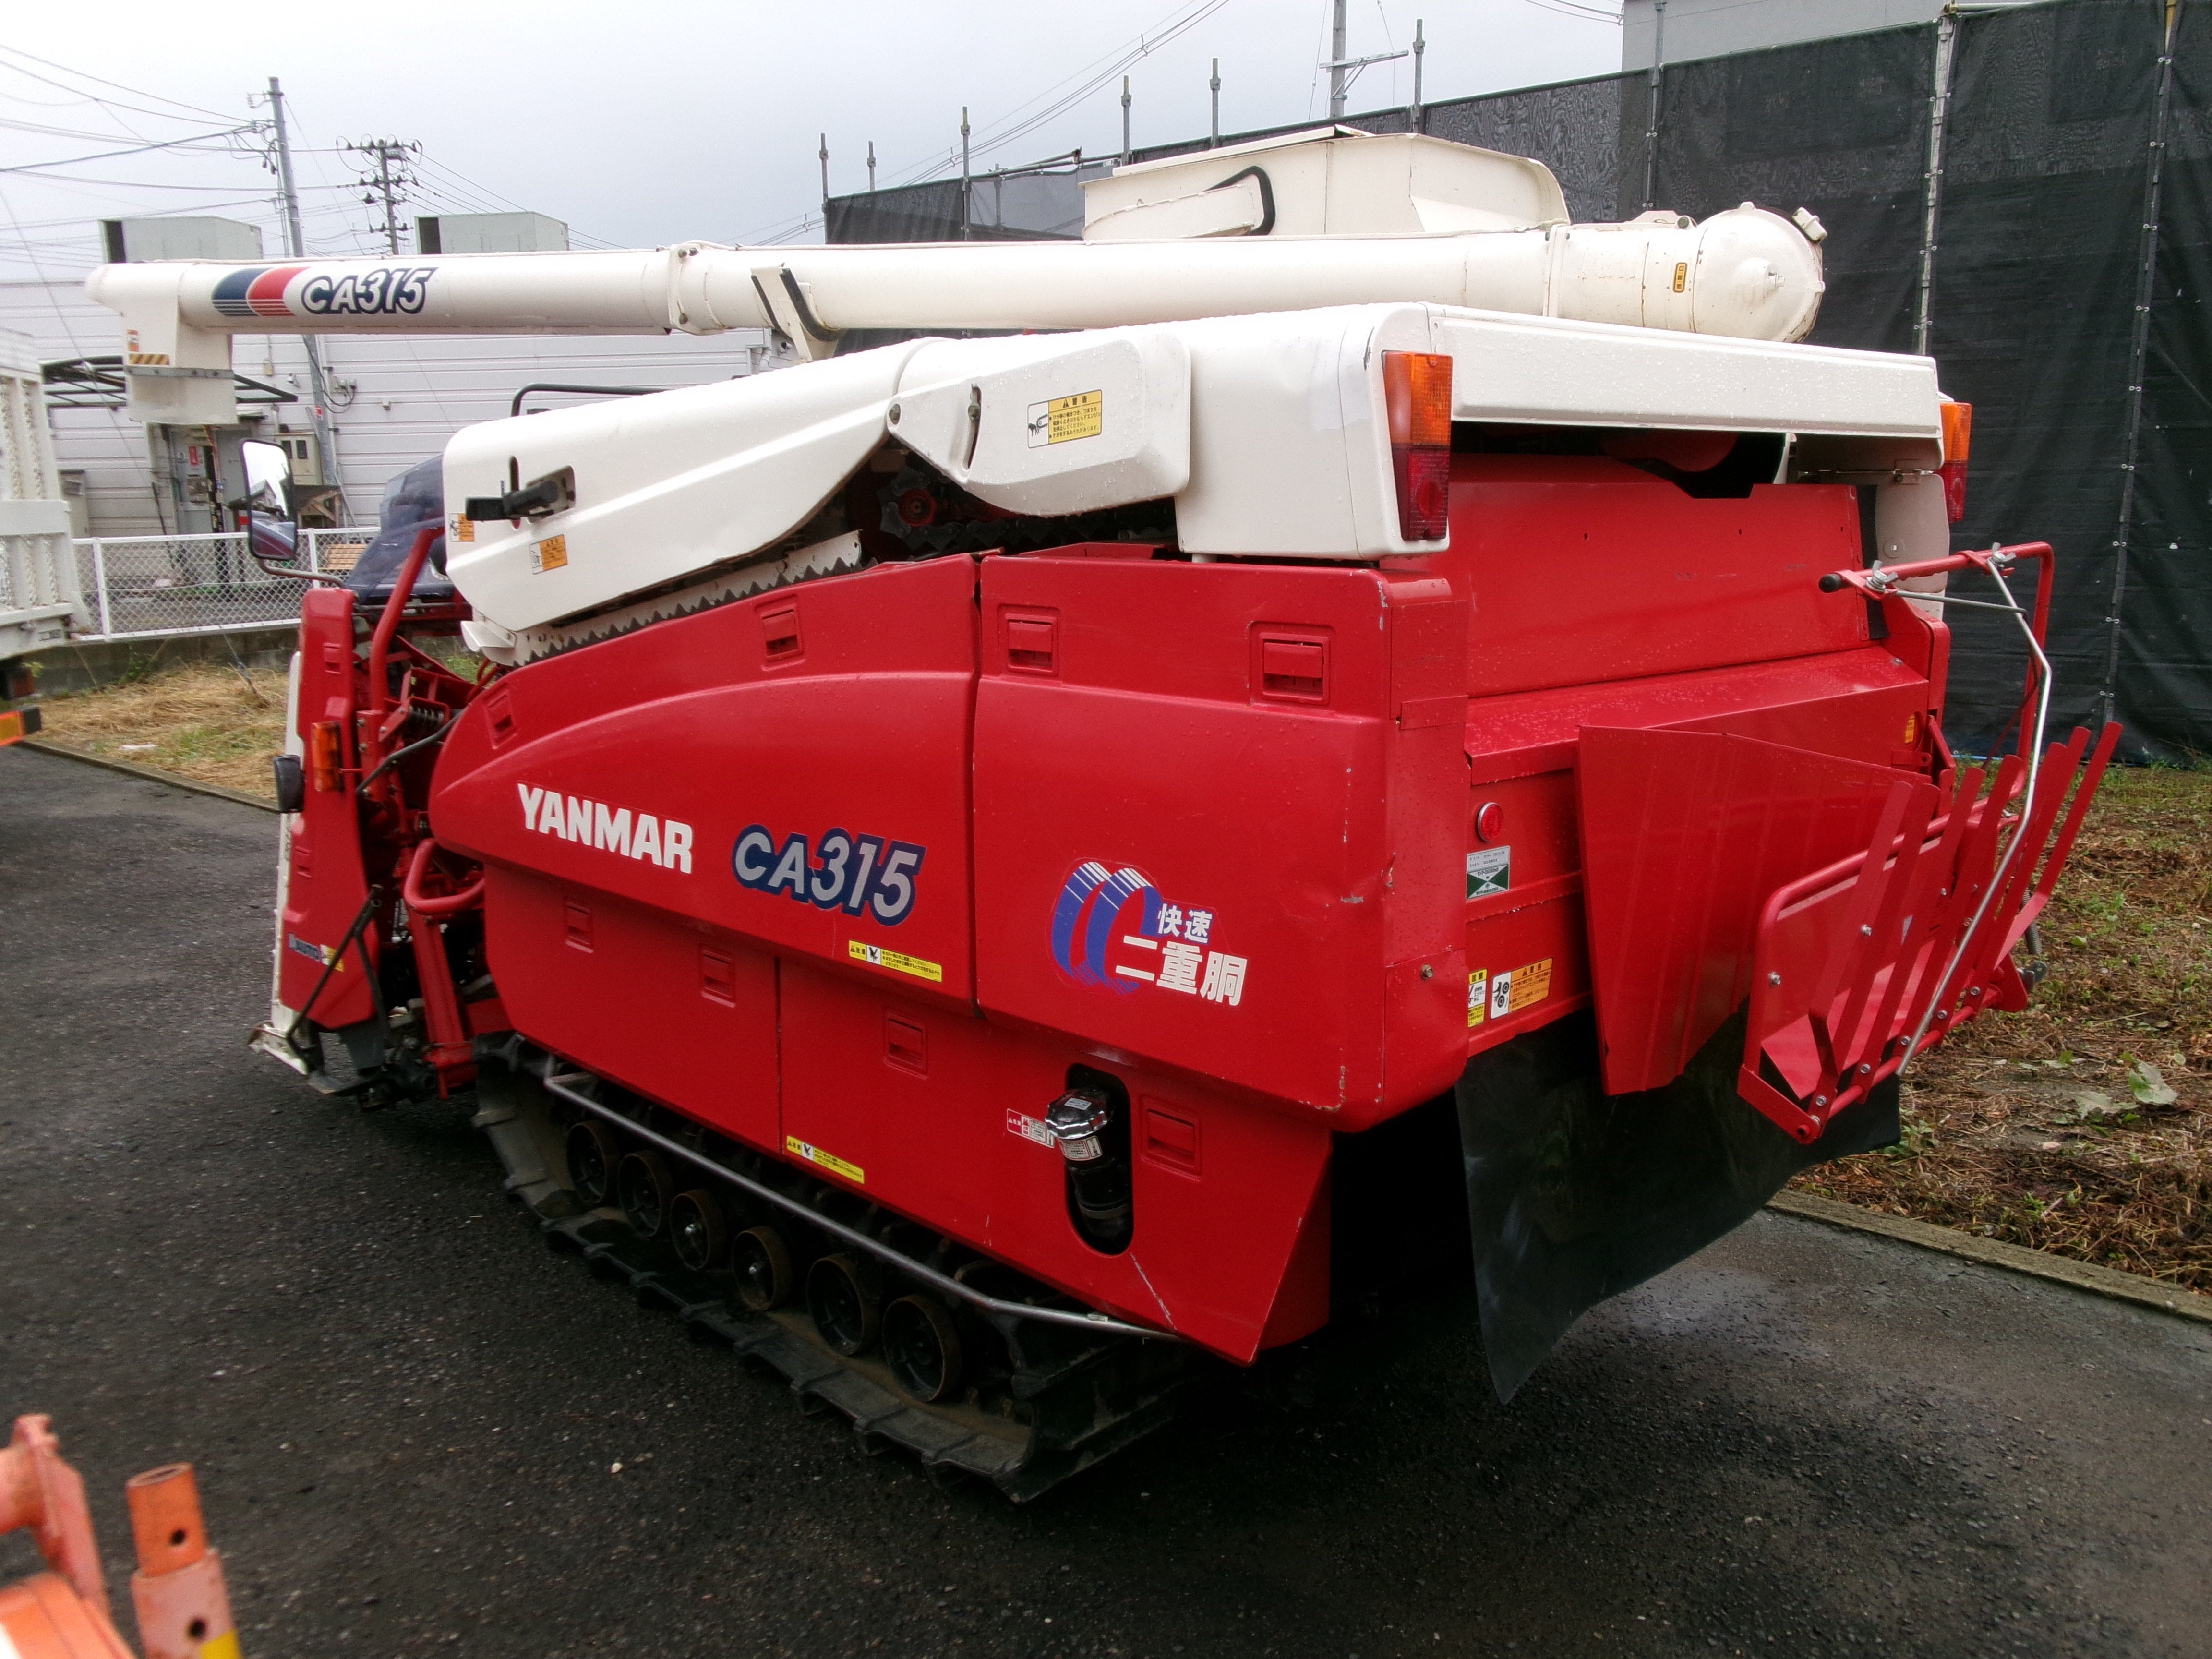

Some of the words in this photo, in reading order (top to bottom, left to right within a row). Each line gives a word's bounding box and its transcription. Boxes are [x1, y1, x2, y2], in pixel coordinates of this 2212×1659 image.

[301, 267, 439, 314] CA315
[517, 783, 693, 874] YANMAR
[732, 824, 926, 926] CA315
[1157, 903, 1213, 944] 快速
[1116, 935, 1248, 1006] 二重胴
